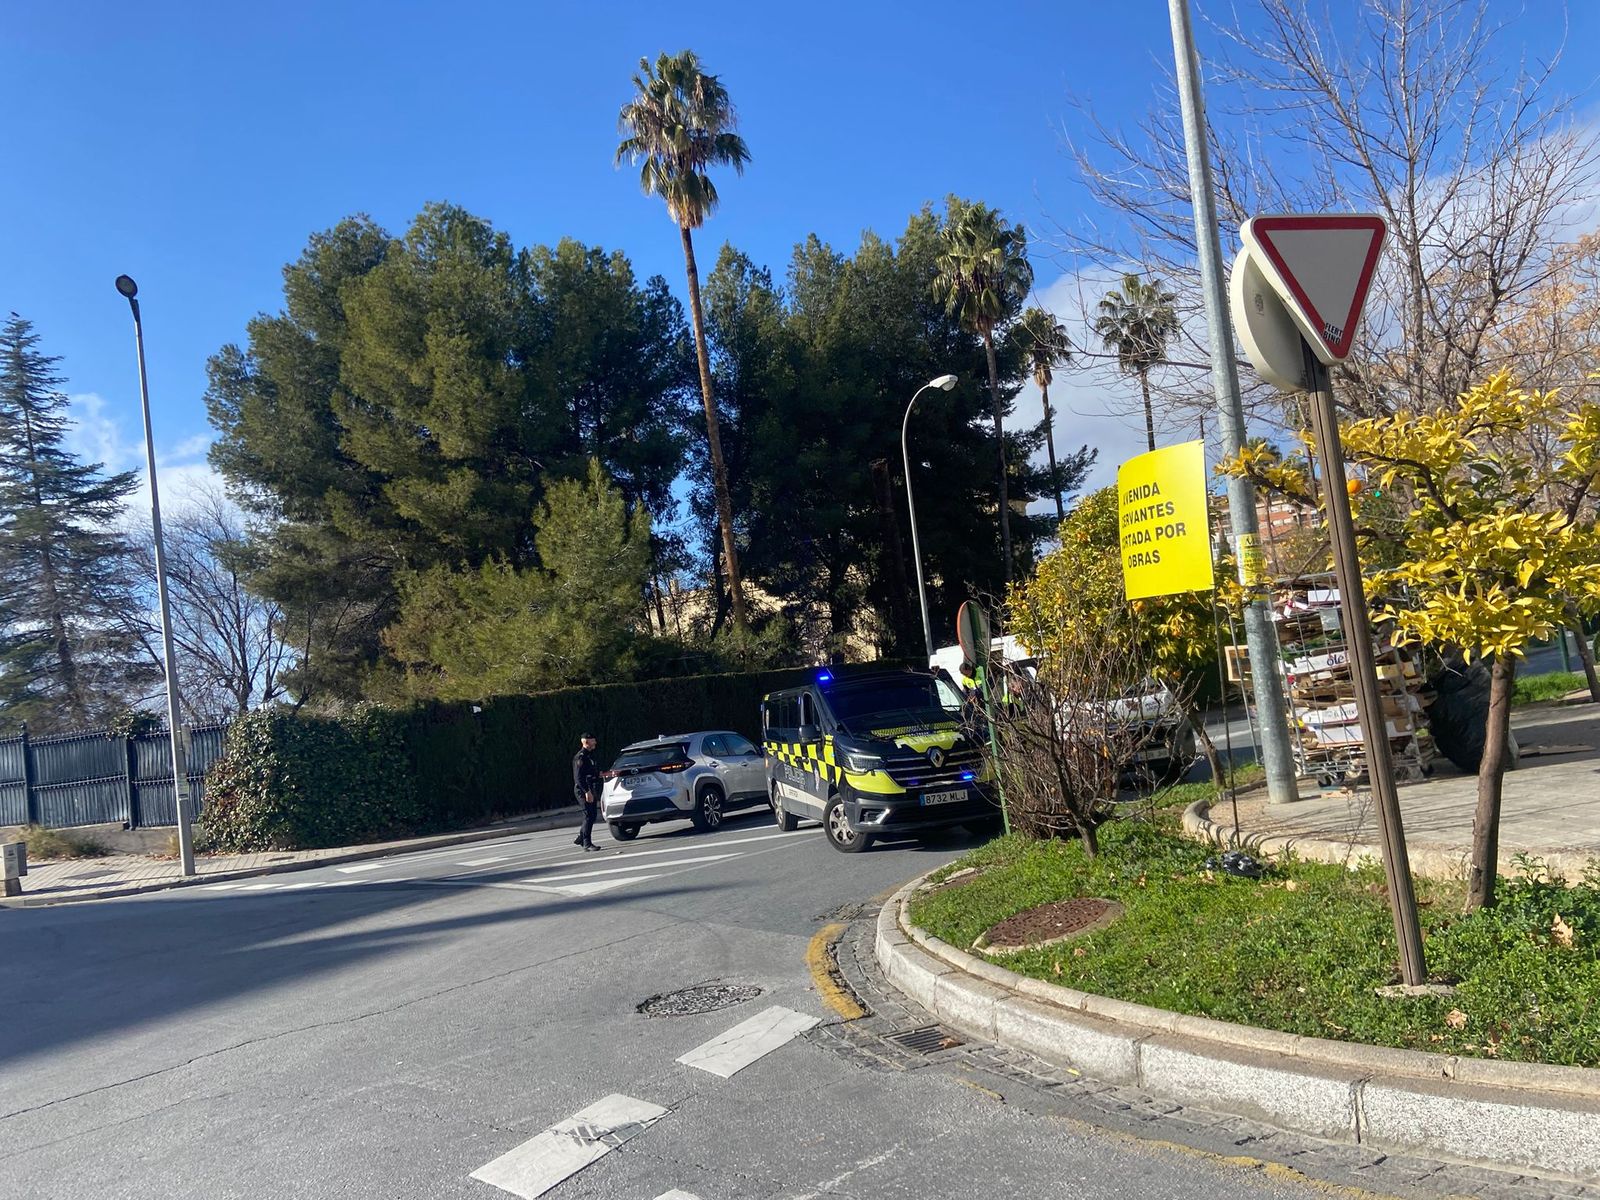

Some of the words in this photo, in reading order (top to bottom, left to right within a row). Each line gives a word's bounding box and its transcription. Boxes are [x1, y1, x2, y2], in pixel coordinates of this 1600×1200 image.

[1155, 522, 1186, 541] POR
[1128, 549, 1160, 569] OBRAS
[926, 793, 947, 804] 8732
[950, 791, 966, 801] MLJ
